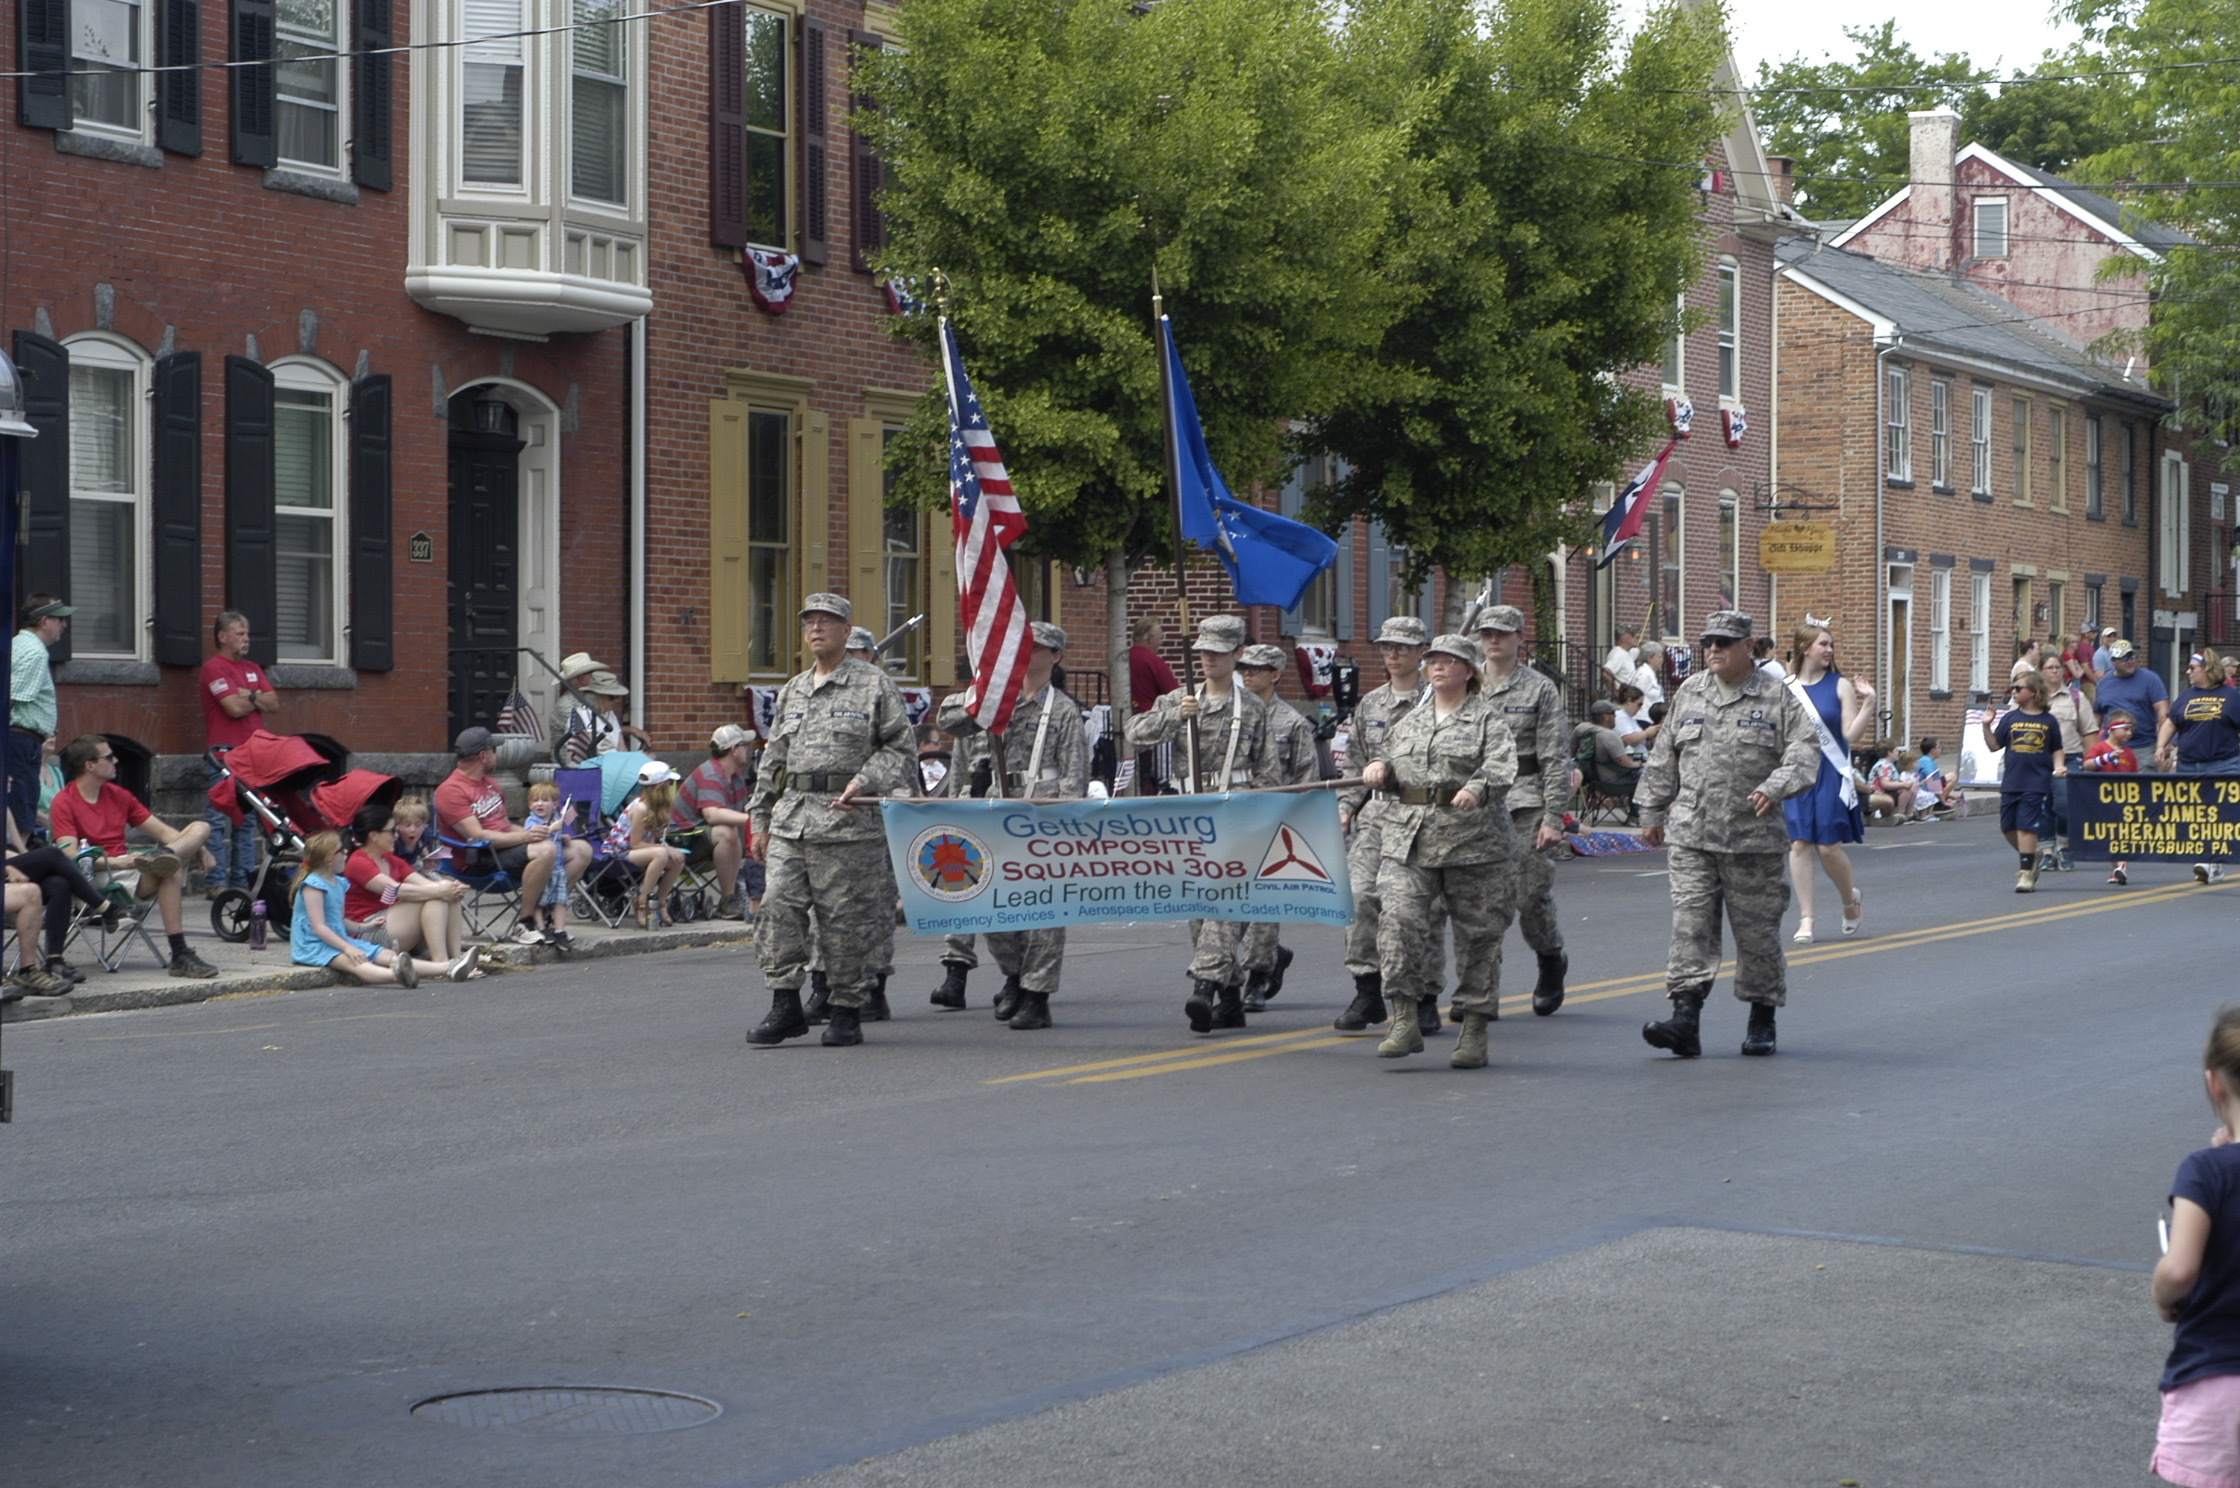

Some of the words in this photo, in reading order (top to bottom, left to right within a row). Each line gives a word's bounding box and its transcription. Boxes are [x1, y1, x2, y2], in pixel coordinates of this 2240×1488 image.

[2099, 781, 2141, 803] CUB
[2151, 781, 2202, 803] PACK
[2214, 781, 2240, 803] 79
[2122, 805, 2149, 823] ST.
[2158, 804, 2219, 823] JAMES
[1002, 813, 1217, 844] Gettysburg
[2083, 822, 2177, 841] LUTHERAN
[1027, 839, 1207, 857] COMPOSITE
[2109, 840, 2205, 855] GETTYSBURG
[2211, 841, 2233, 856] PA.
[1001, 860, 1176, 882] SQUADRON
[1182, 858, 1248, 880] 308
[992, 884, 1053, 909] Lead
[1062, 882, 1126, 903] From
[1133, 880, 1173, 900] the
[1181, 880, 1250, 902] Front!
[1255, 882, 1281, 891] CIVIL
[1282, 882, 1300, 891] AIR
[1302, 883, 1337, 895] PATROL
[916, 914, 993, 931] Emergency
[997, 908, 1056, 925] Services
[1077, 904, 1150, 918] Aerospace
[1153, 901, 1220, 915] Education
[1240, 902, 1281, 916] Cadet
[1284, 903, 1347, 920] Programs
